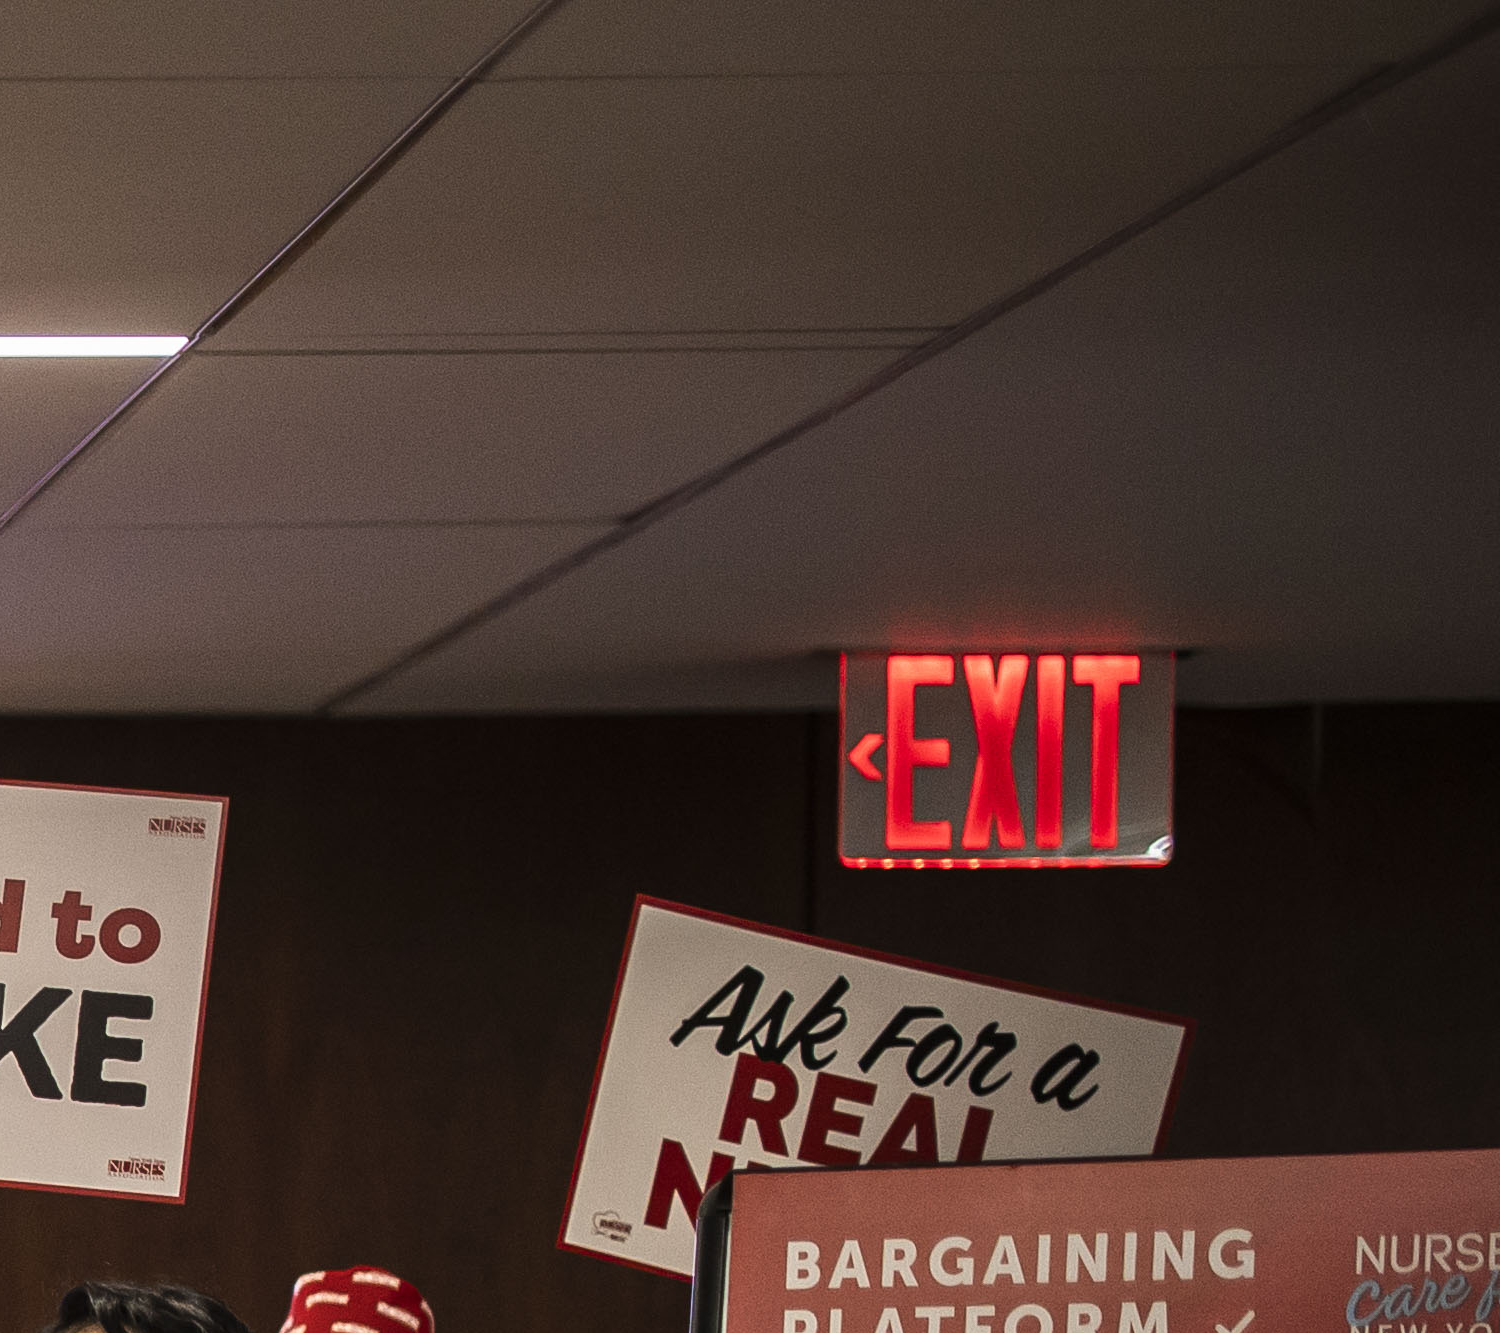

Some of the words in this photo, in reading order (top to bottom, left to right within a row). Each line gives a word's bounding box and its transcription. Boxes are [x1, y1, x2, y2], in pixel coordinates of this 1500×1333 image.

[886, 654, 1141, 849] EXIT
[147, 818, 206, 833] NURSES
[52, 890, 161, 964] to
[670, 965, 850, 1071] Ask
[860, 1006, 1016, 1098] For
[1031, 1043, 1100, 1110] a
[785, 1228, 1255, 1290] BARGAINING
[1347, 1280, 1470, 1327] Care
